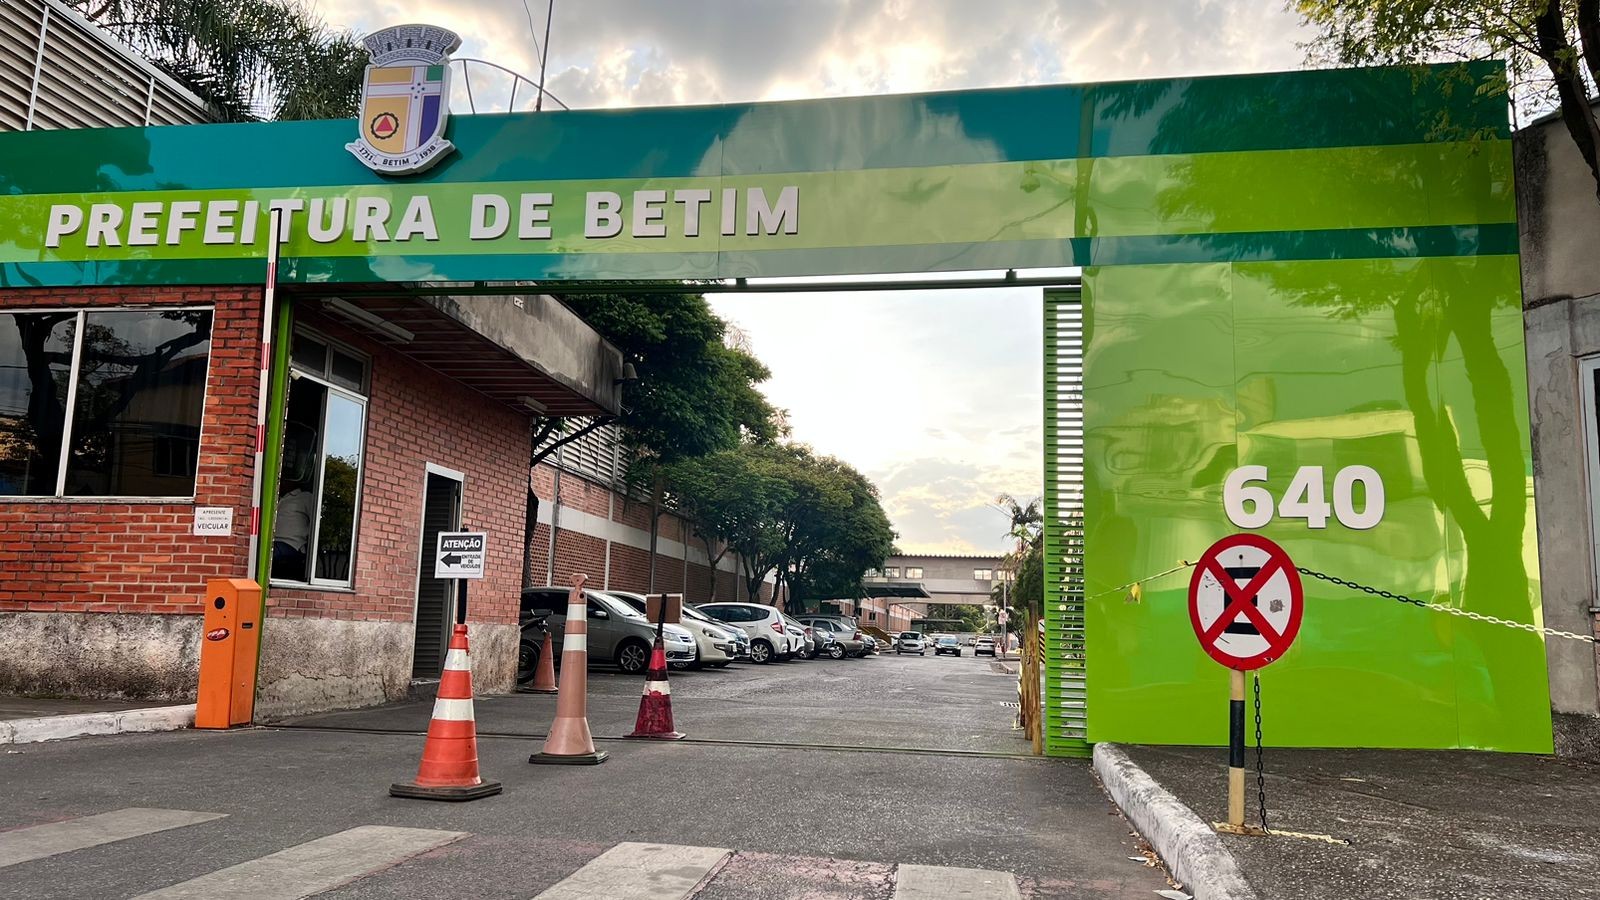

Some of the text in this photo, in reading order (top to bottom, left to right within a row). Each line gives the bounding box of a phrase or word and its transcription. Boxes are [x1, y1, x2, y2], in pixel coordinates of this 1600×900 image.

[359, 147, 373, 161] 1711
[419, 145, 436, 159] 1938
[382, 158, 410, 166] BETIM
[44, 186, 800, 248] PREFEITURA DE BETIM
[1223, 465, 1385, 530] 640
[443, 538, 481, 550] ATENÇÃO
